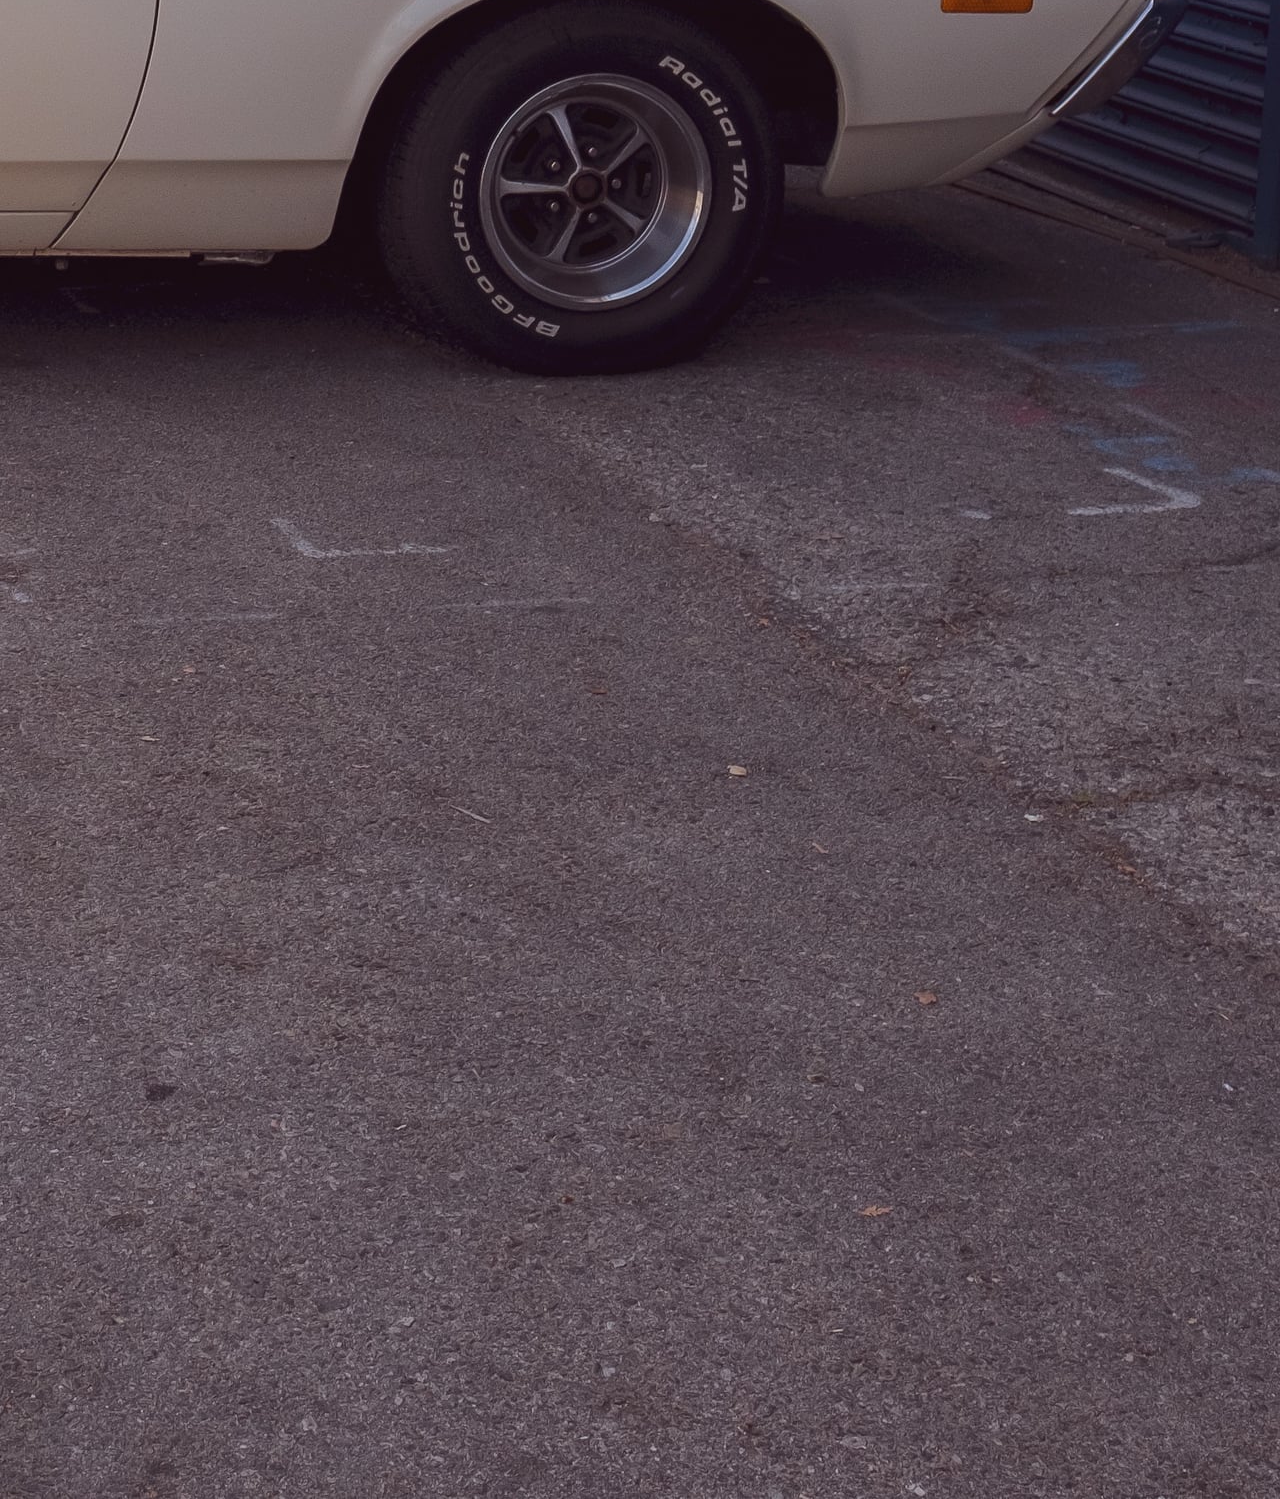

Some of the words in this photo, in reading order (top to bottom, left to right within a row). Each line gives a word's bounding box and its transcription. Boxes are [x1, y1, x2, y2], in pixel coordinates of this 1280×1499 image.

[658, 55, 742, 147] Radial
[731, 158, 748, 212] T/A
[449, 152, 561, 337] BFGoodrich
